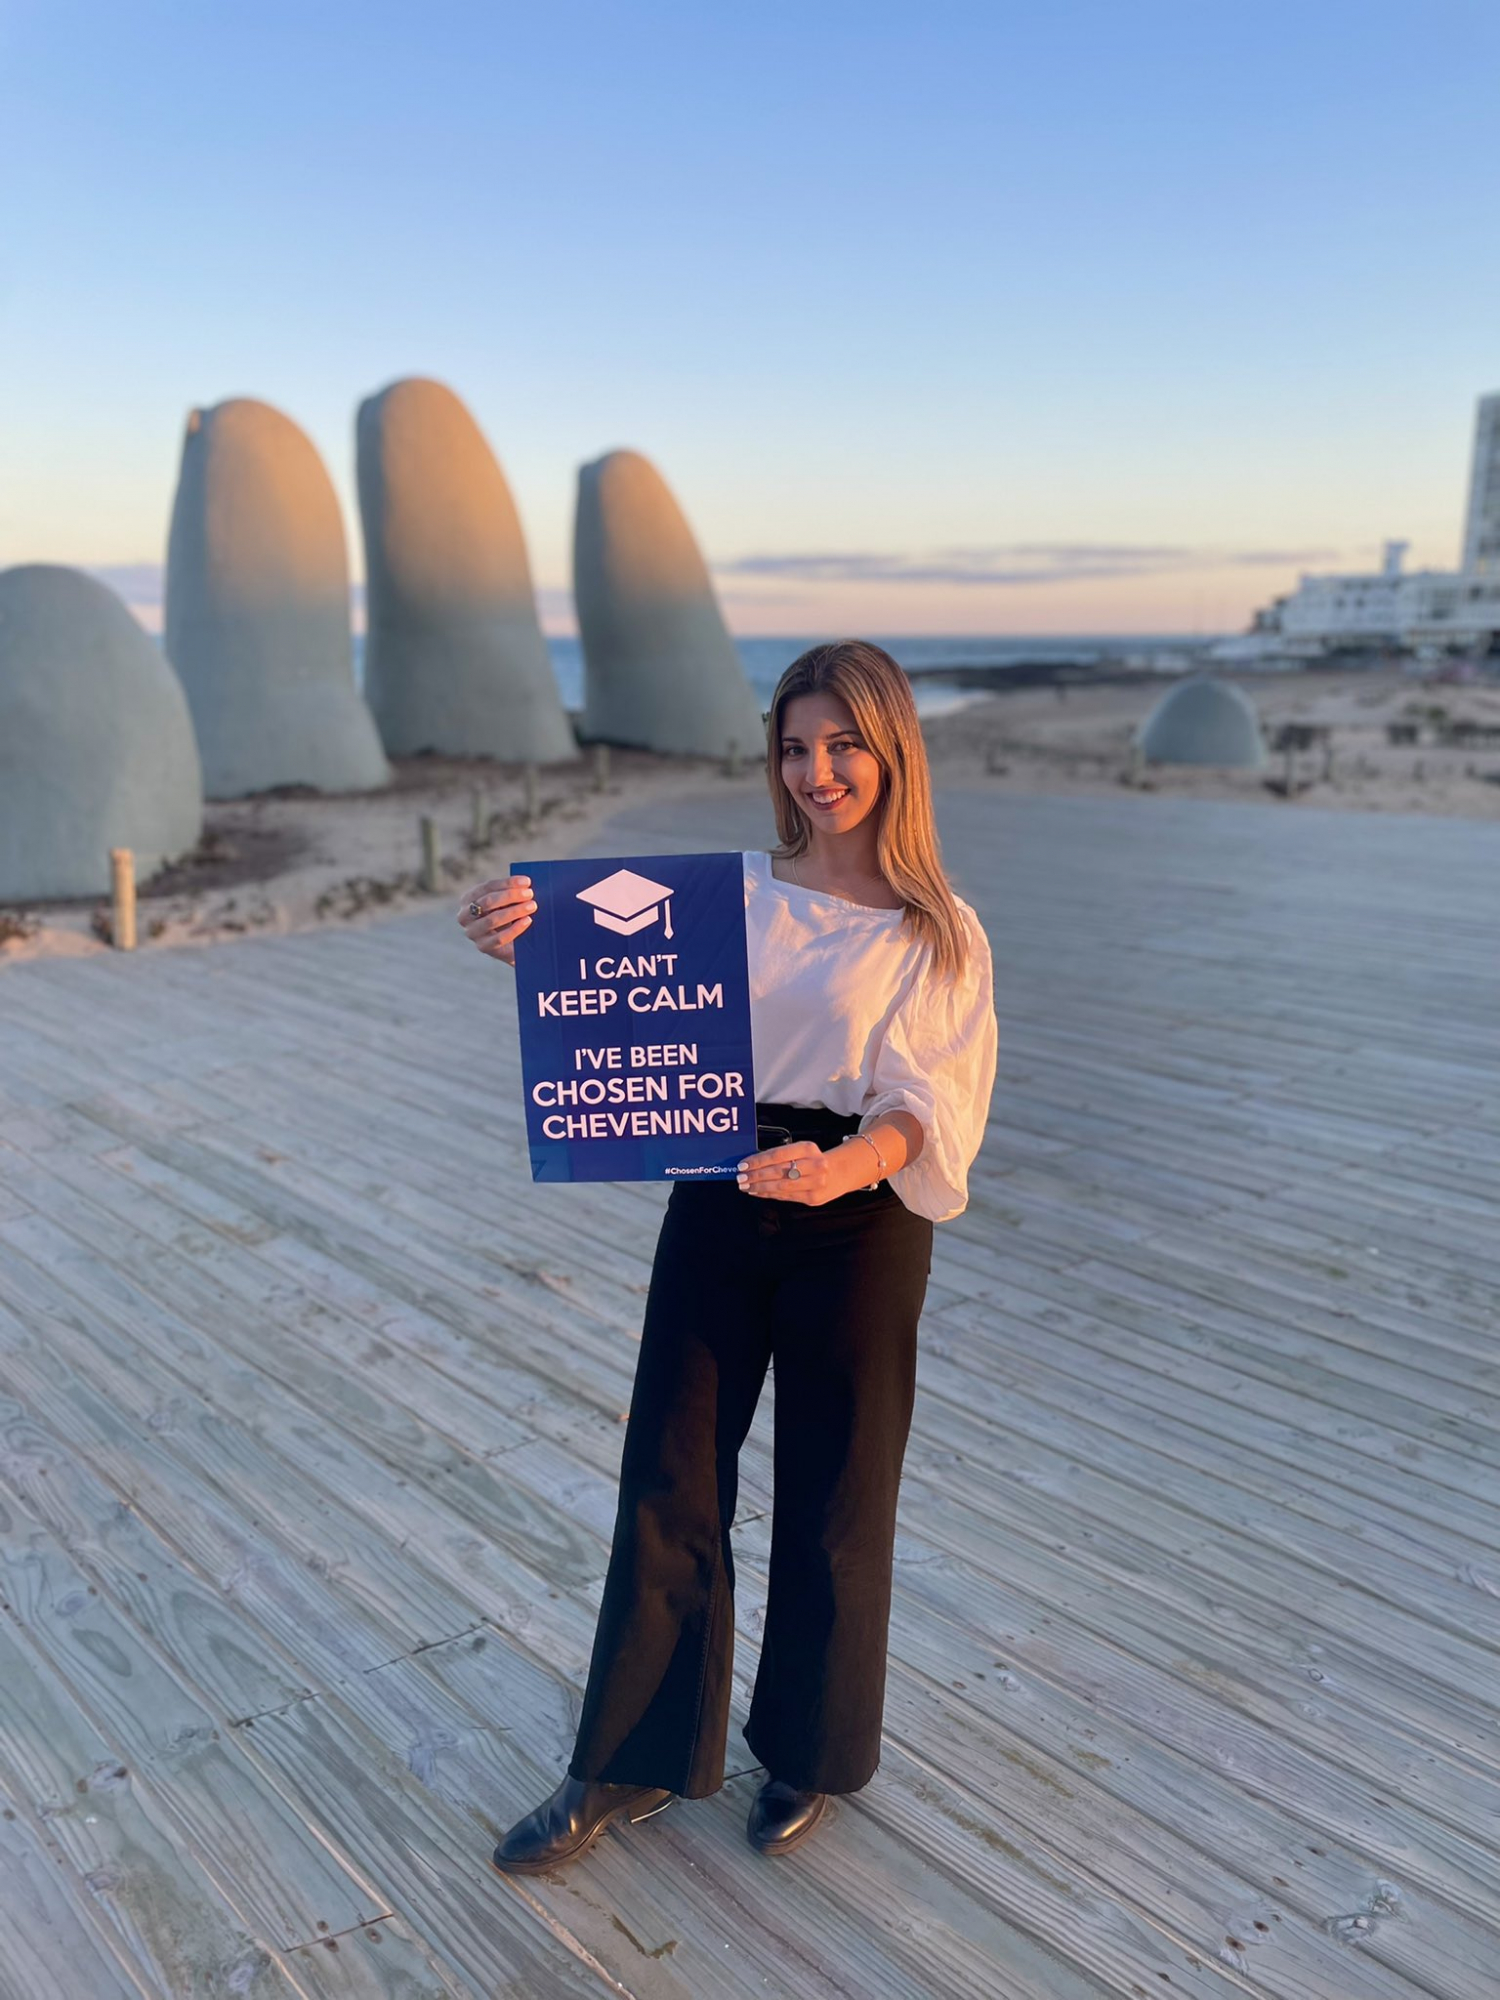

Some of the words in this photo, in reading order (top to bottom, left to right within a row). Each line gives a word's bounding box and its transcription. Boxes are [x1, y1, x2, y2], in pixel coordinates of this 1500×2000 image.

[580, 958, 587, 980] I
[538, 989, 618, 1017] KEEP
[627, 983, 724, 1012] CALM
[630, 1043, 698, 1067] BEEN
[532, 1075, 668, 1107] CHOSEN
[679, 1071, 745, 1100] FOR
[542, 1106, 739, 1139] CHEVENING!
[665, 1166, 738, 1175] #ChosenForCheve
